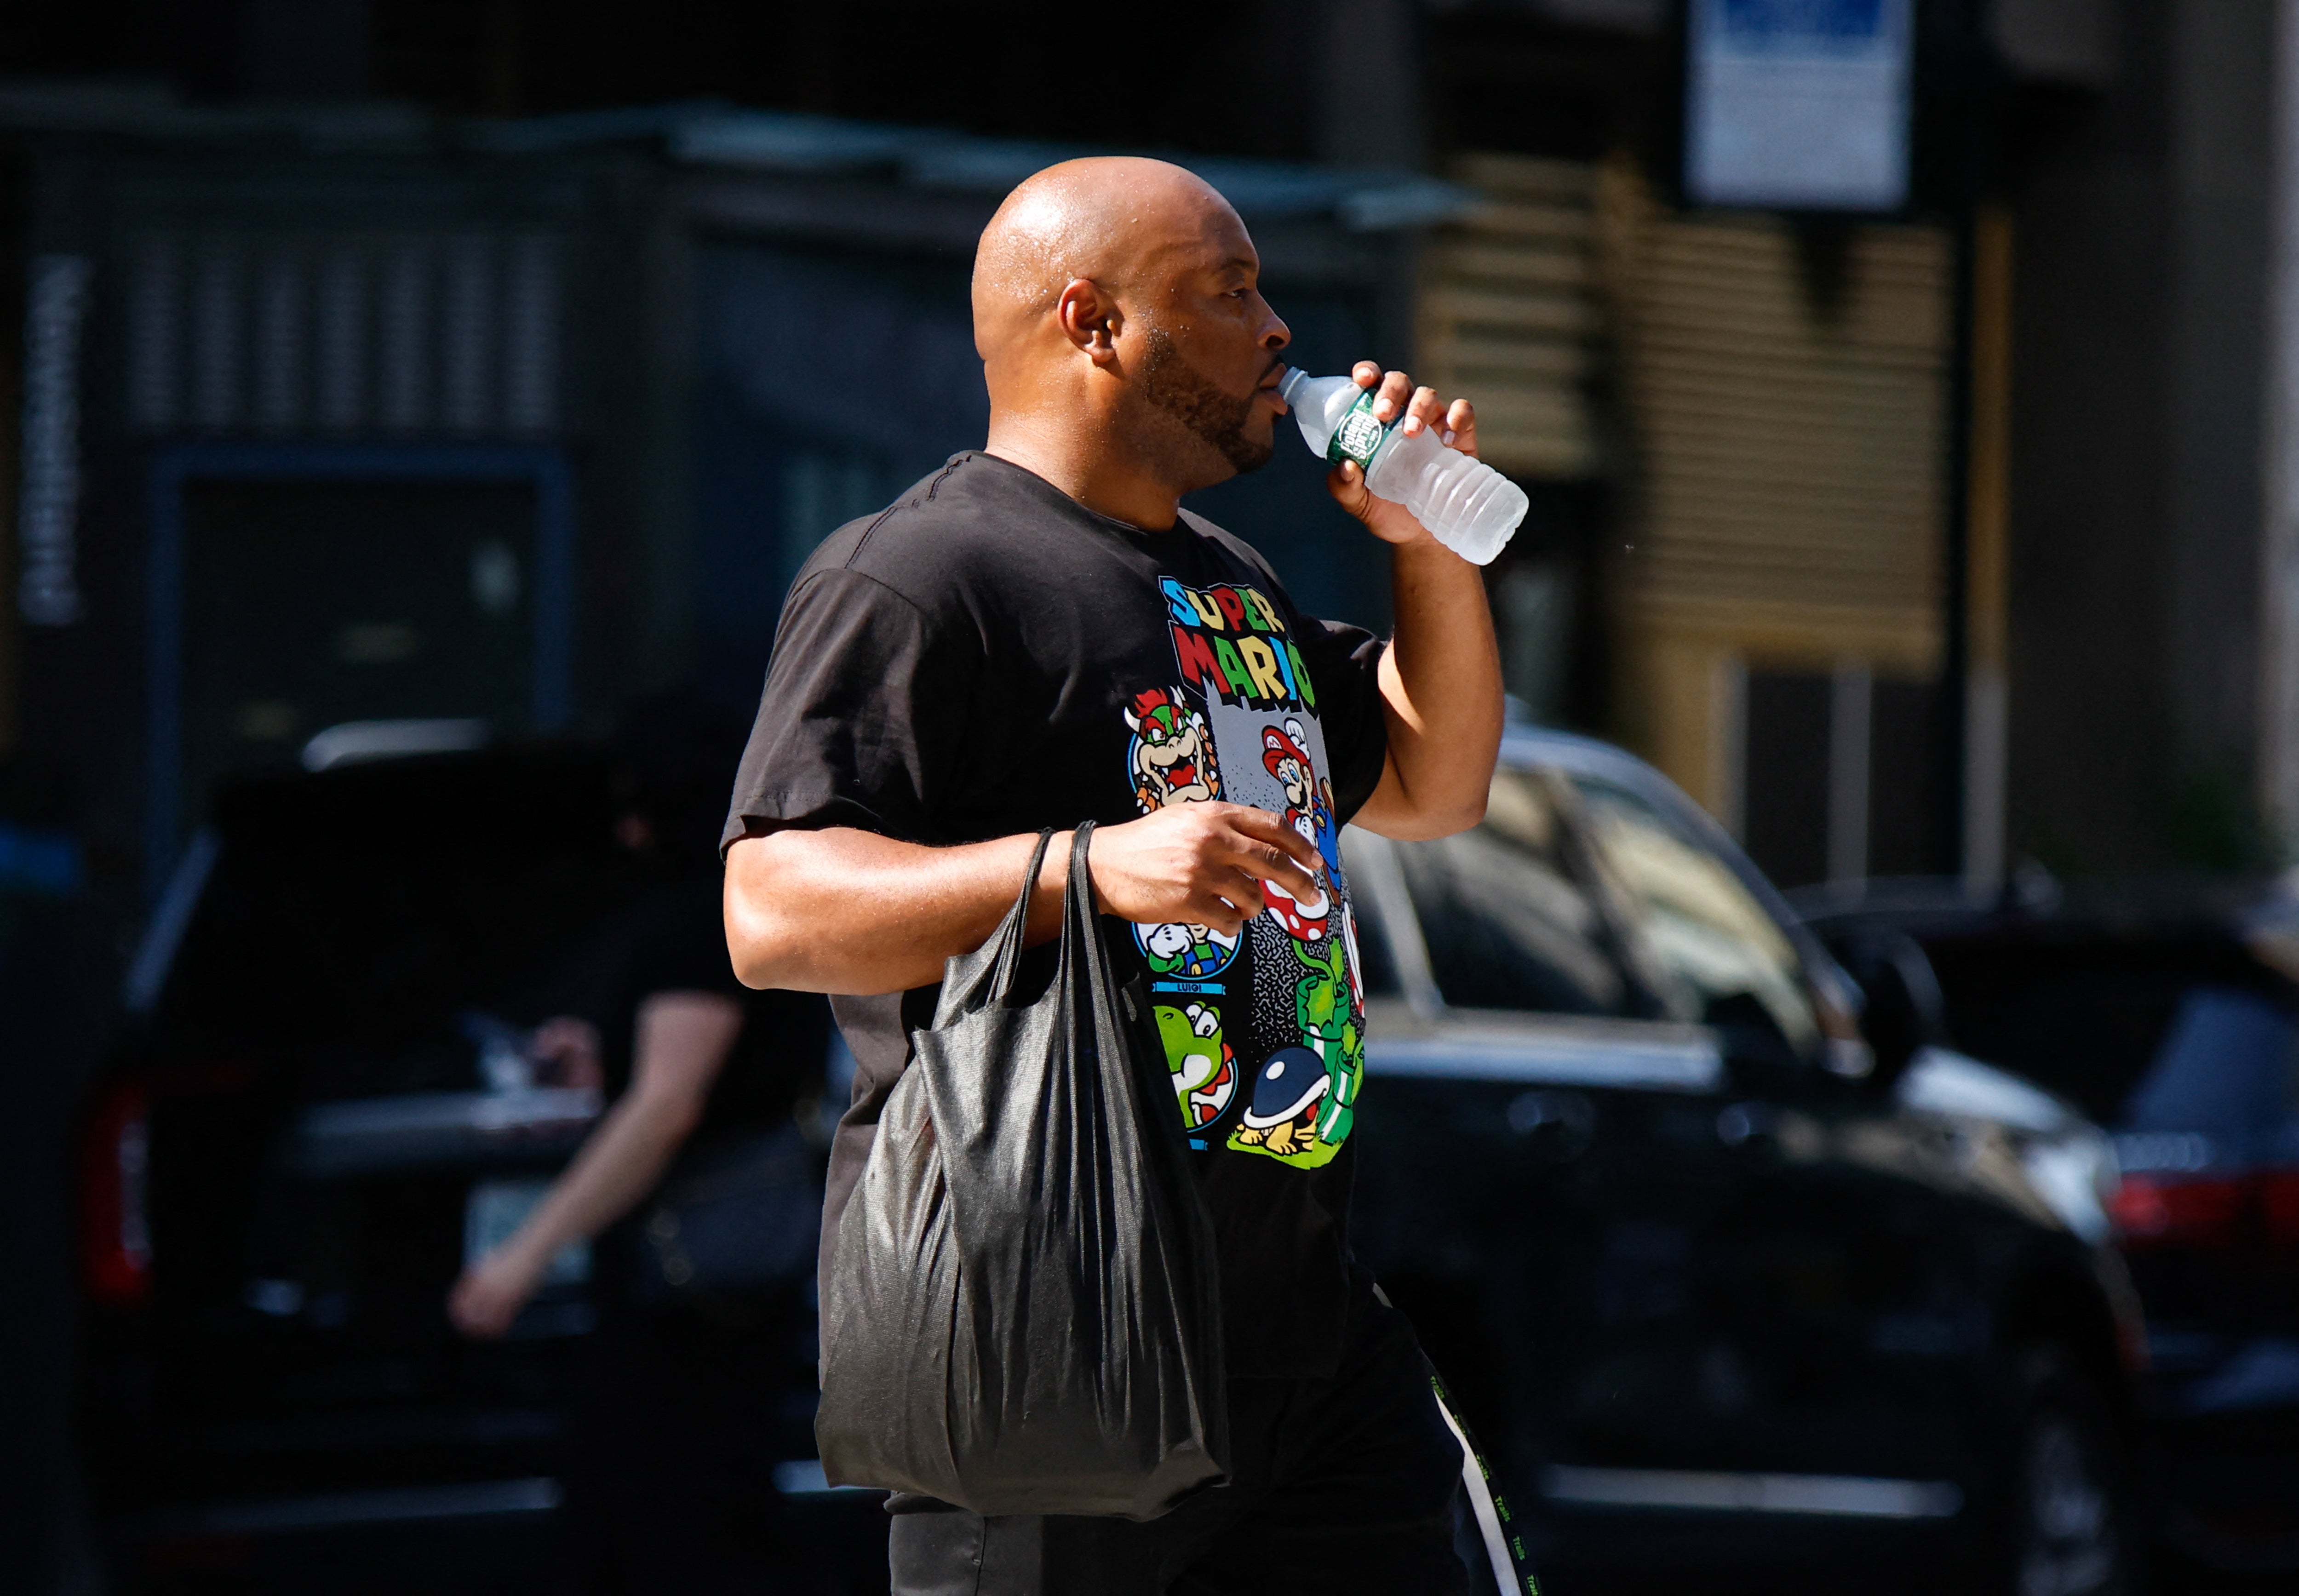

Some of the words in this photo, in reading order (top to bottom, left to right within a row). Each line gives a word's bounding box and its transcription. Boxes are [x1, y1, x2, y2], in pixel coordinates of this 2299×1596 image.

[1341, 408, 1368, 455] Poland
[1353, 415, 1380, 460] Spring
[1162, 579, 1285, 632] SUPER
[1173, 626, 1316, 708] MARIO
[1268, 738, 1280, 749] M
[1177, 983, 1202, 992] LUIGI
[1495, 1496, 1510, 1522] Trails
[1527, 1574, 1538, 1596] Trail
